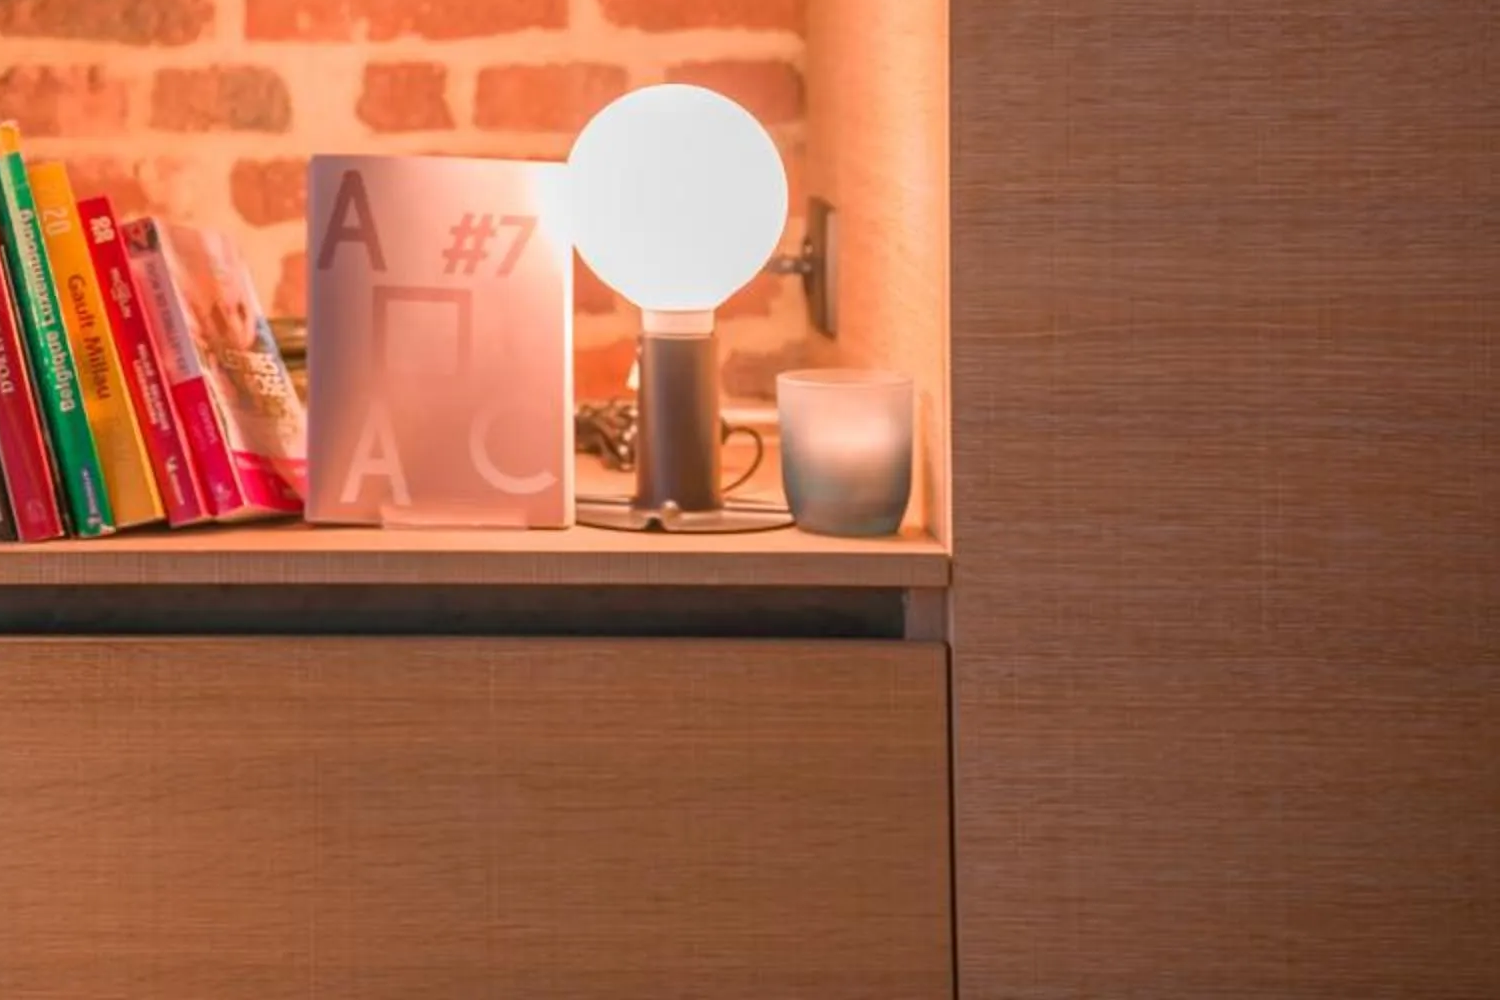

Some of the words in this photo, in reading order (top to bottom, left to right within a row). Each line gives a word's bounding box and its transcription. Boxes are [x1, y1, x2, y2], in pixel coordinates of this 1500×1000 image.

[18, 205, 56, 328] Luxembourg
[317, 169, 388, 273] A
[442, 212, 540, 278] #7
[44, 326, 75, 414] Belgique
[67, 271, 95, 332] Gault
[82, 333, 109, 402] Millau
[340, 398, 412, 507] A
